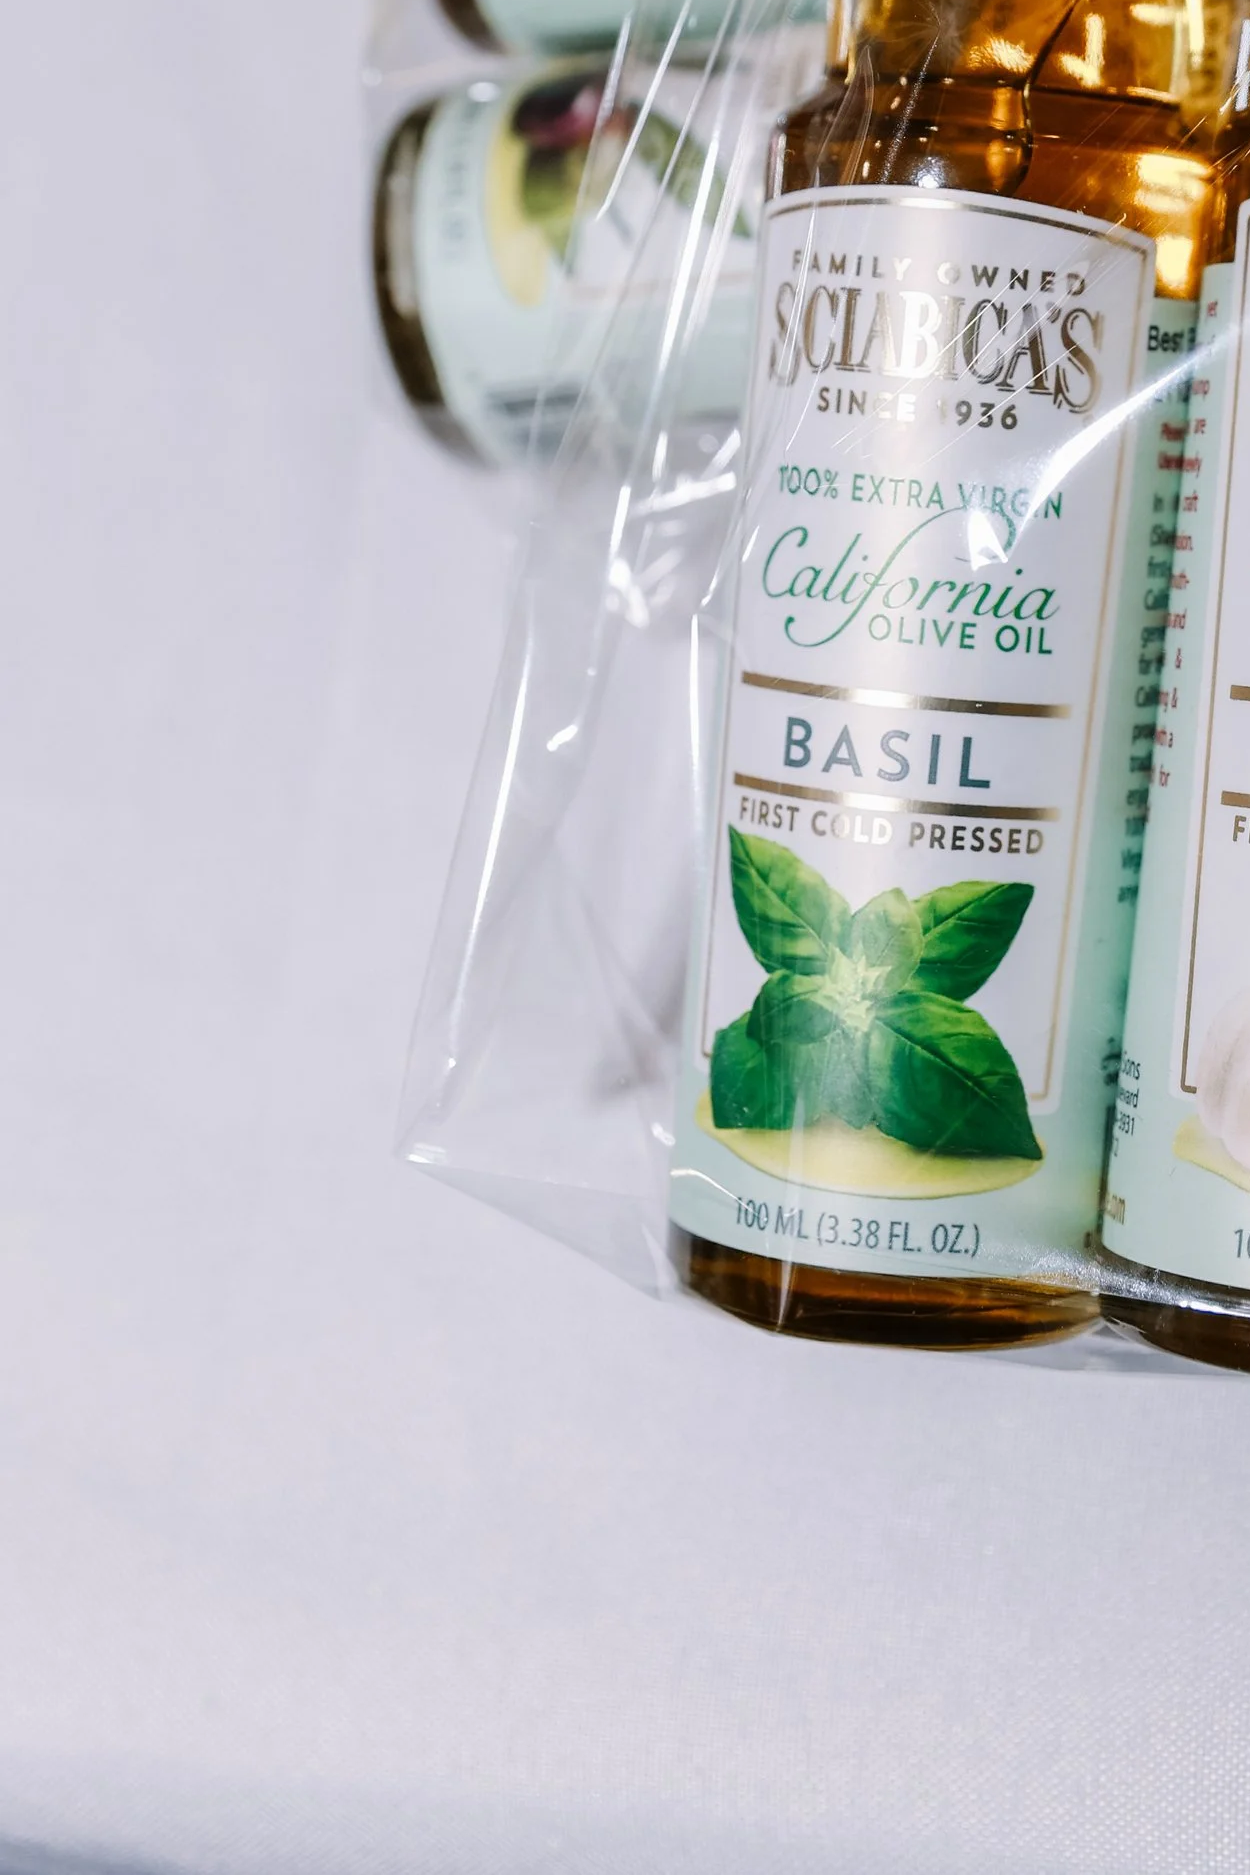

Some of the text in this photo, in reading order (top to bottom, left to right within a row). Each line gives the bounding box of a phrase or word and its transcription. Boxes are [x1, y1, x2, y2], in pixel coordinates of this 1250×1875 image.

[793, 249, 1086, 297] FAMILY OWNED
[817, 386, 917, 423] SINCE
[779, 464, 1064, 520] 100% EXTRA VIRGN
[763, 505, 1062, 648] California
[867, 613, 1054, 656] OLIVE OIL
[783, 716, 991, 790] BASIL
[739, 796, 1045, 855] FIRST COLD PRESSED
[735, 1196, 980, 1259] 100 ML (3.38 FL. OZ.)
